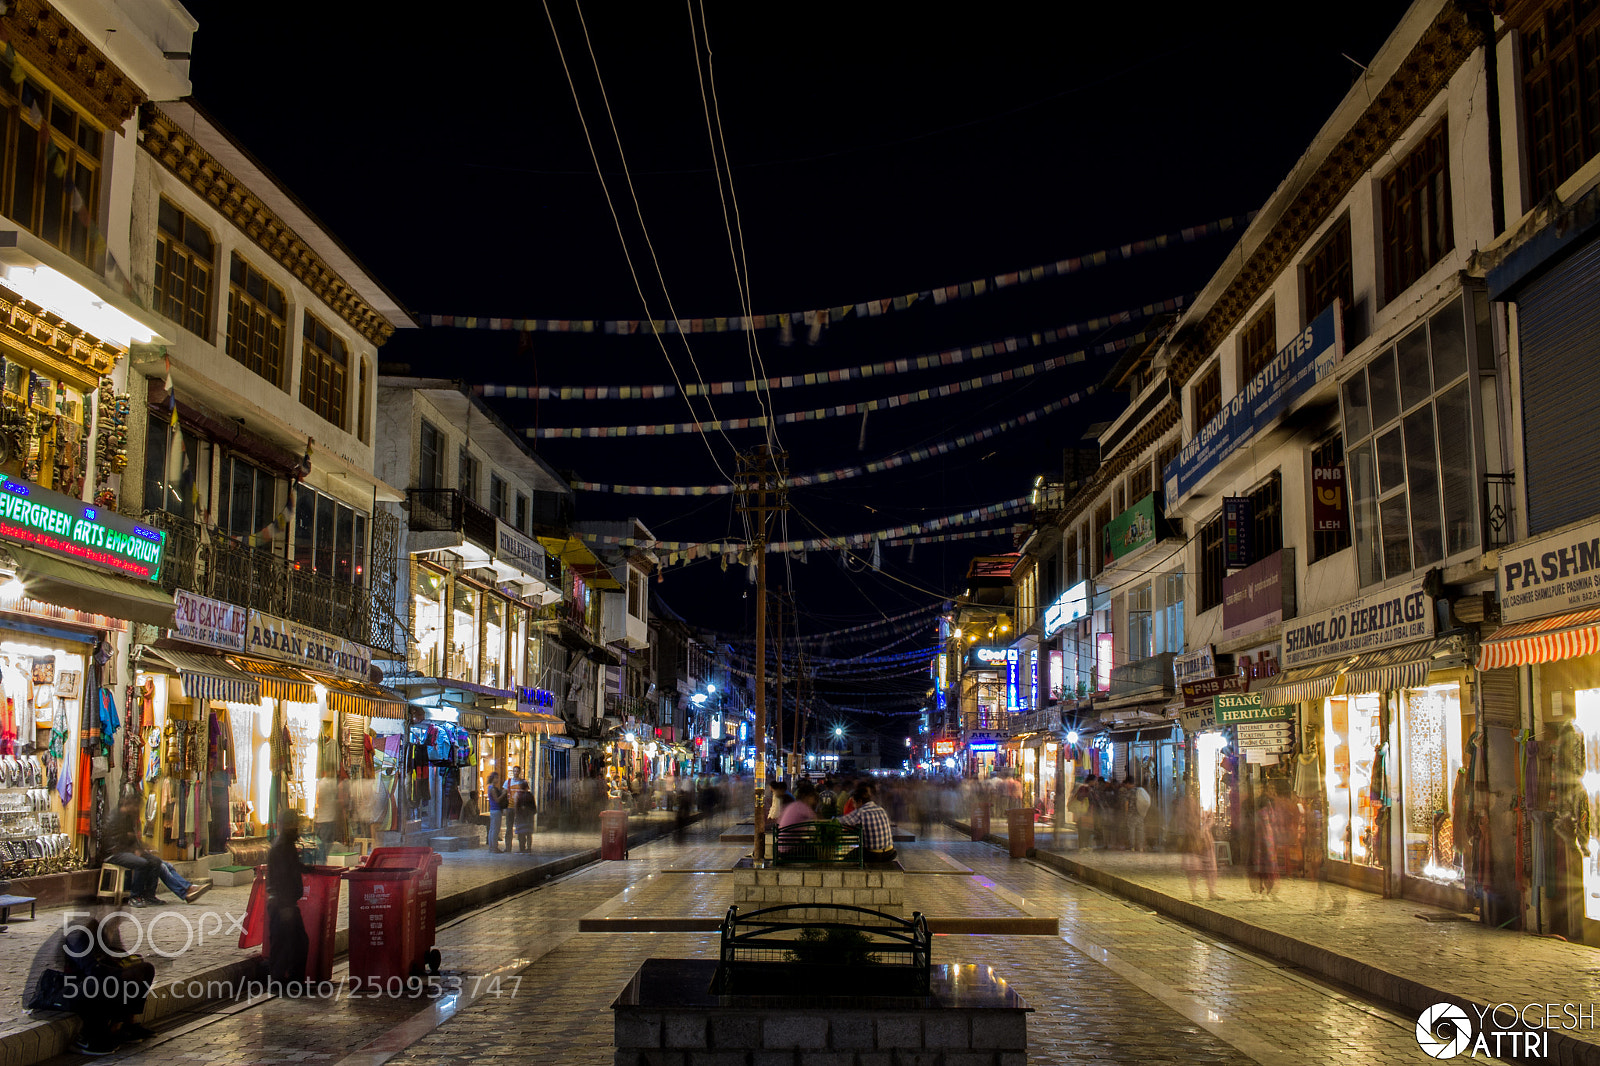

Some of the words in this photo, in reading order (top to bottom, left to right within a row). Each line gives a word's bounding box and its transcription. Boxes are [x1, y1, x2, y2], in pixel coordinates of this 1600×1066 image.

[1180, 436, 1200, 468] KAWA
[1201, 408, 1230, 447] GROUP
[1232, 393, 1244, 417] OF
[1247, 326, 1313, 404] INSTITUTES
[1314, 468, 1341, 480] PNB
[0, 492, 73, 537] EVERGREEN
[73, 518, 106, 547] ARTS
[105, 528, 161, 564] EMPORIUM
[1319, 520, 1340, 529] LEH
[500, 531, 531, 564] HIMALAYAN
[1510, 591, 1534, 607] CASHMERE
[1567, 576, 1593, 593] PASHMINA
[176, 596, 197, 622] FAB
[1286, 615, 1346, 653] SHANGLOO
[1350, 591, 1425, 637] HERITAGE
[1384, 629, 1393, 642] OLD
[1393, 625, 1408, 640] TRIBAL
[179, 623, 198, 639] HOUSE
[199, 628, 206, 640] OF
[208, 630, 240, 648] PASHMINAS
[251, 626, 303, 656] ASIAN
[306, 641, 368, 675] EMPORIUM
[1194, 681, 1219, 695] PNB
[1219, 695, 1261, 708] SHANG
[1223, 707, 1286, 721] HERITAGE
[1184, 709, 1200, 720] THE
